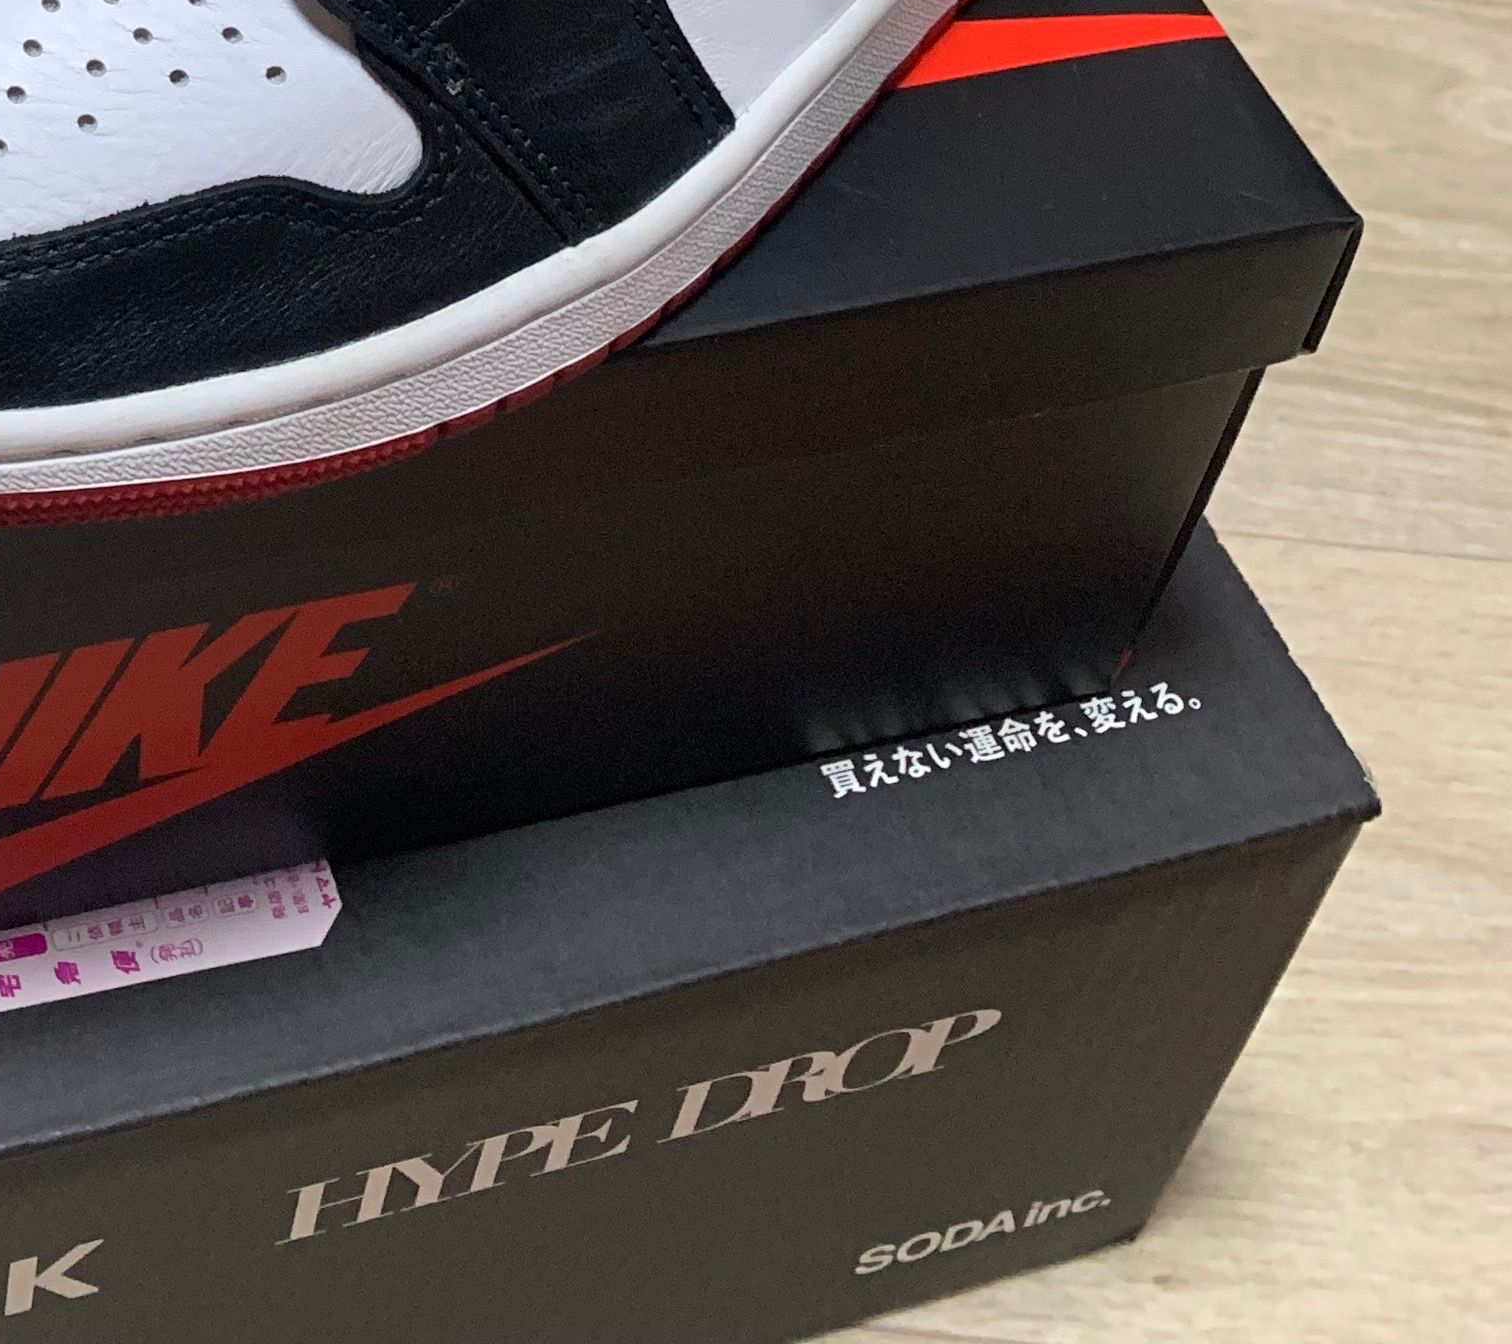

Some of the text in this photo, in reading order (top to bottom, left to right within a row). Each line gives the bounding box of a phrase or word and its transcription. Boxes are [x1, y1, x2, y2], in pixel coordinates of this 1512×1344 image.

[819, 681, 1203, 799] 買えない運命を、変える。
[274, 1008, 1003, 1245] HYPE DROP
[853, 1189, 1112, 1275] SODA inc.
